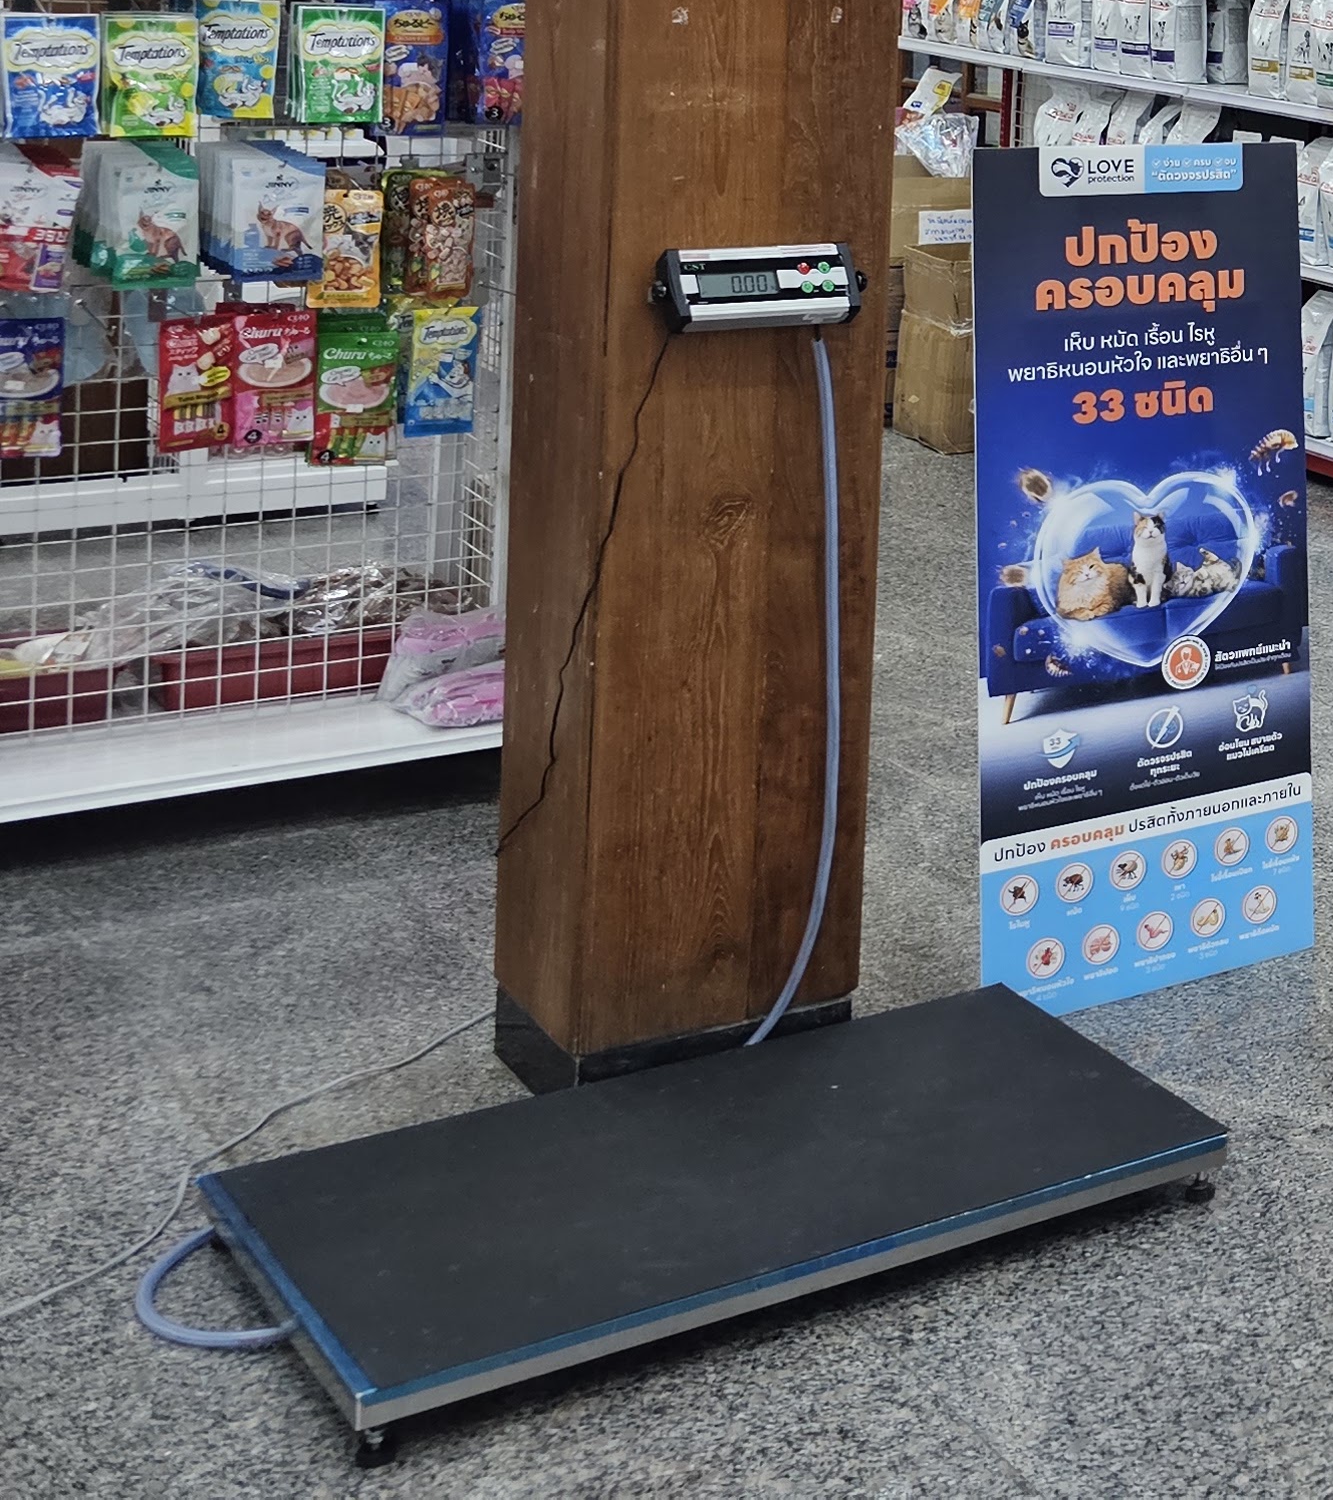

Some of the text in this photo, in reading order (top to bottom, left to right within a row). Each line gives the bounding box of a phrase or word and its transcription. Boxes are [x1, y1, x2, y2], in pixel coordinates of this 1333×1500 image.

[202, 23, 270, 44] Temptations
[310, 33, 377, 52] Temptations
[14, 40, 90, 62] Temptations
[118, 45, 187, 67] Temptations
[1088, 158, 1134, 174] LOVE
[1193, 158, 1212, 167] ครบ
[1088, 174, 1135, 185] protection
[1065, 218, 1218, 267] ปกป้อง
[684, 263, 706, 271] CST
[731, 274, 768, 294] 0.00
[1035, 268, 1246, 313] ครอบคลุม
[240, 326, 282, 340] Churu
[424, 322, 469, 342] Temptations
[1064, 321, 1217, 354] เห็บ หมัด เรื้อน ไรหู
[323, 347, 367, 361] Churu
[1007, 350, 1153, 384] พยาธิหนอนหัวใจ
[1157, 341, 1252, 373] และพยาธิอื่น
[1072, 379, 1215, 426] 33 ชนิด
[1023, 769, 1098, 792] ปกป้องครอบคลุม
[994, 784, 1302, 863] ปกป้อง ครอบคลุม ปรสิตทั้งภายนอกและภายใน
